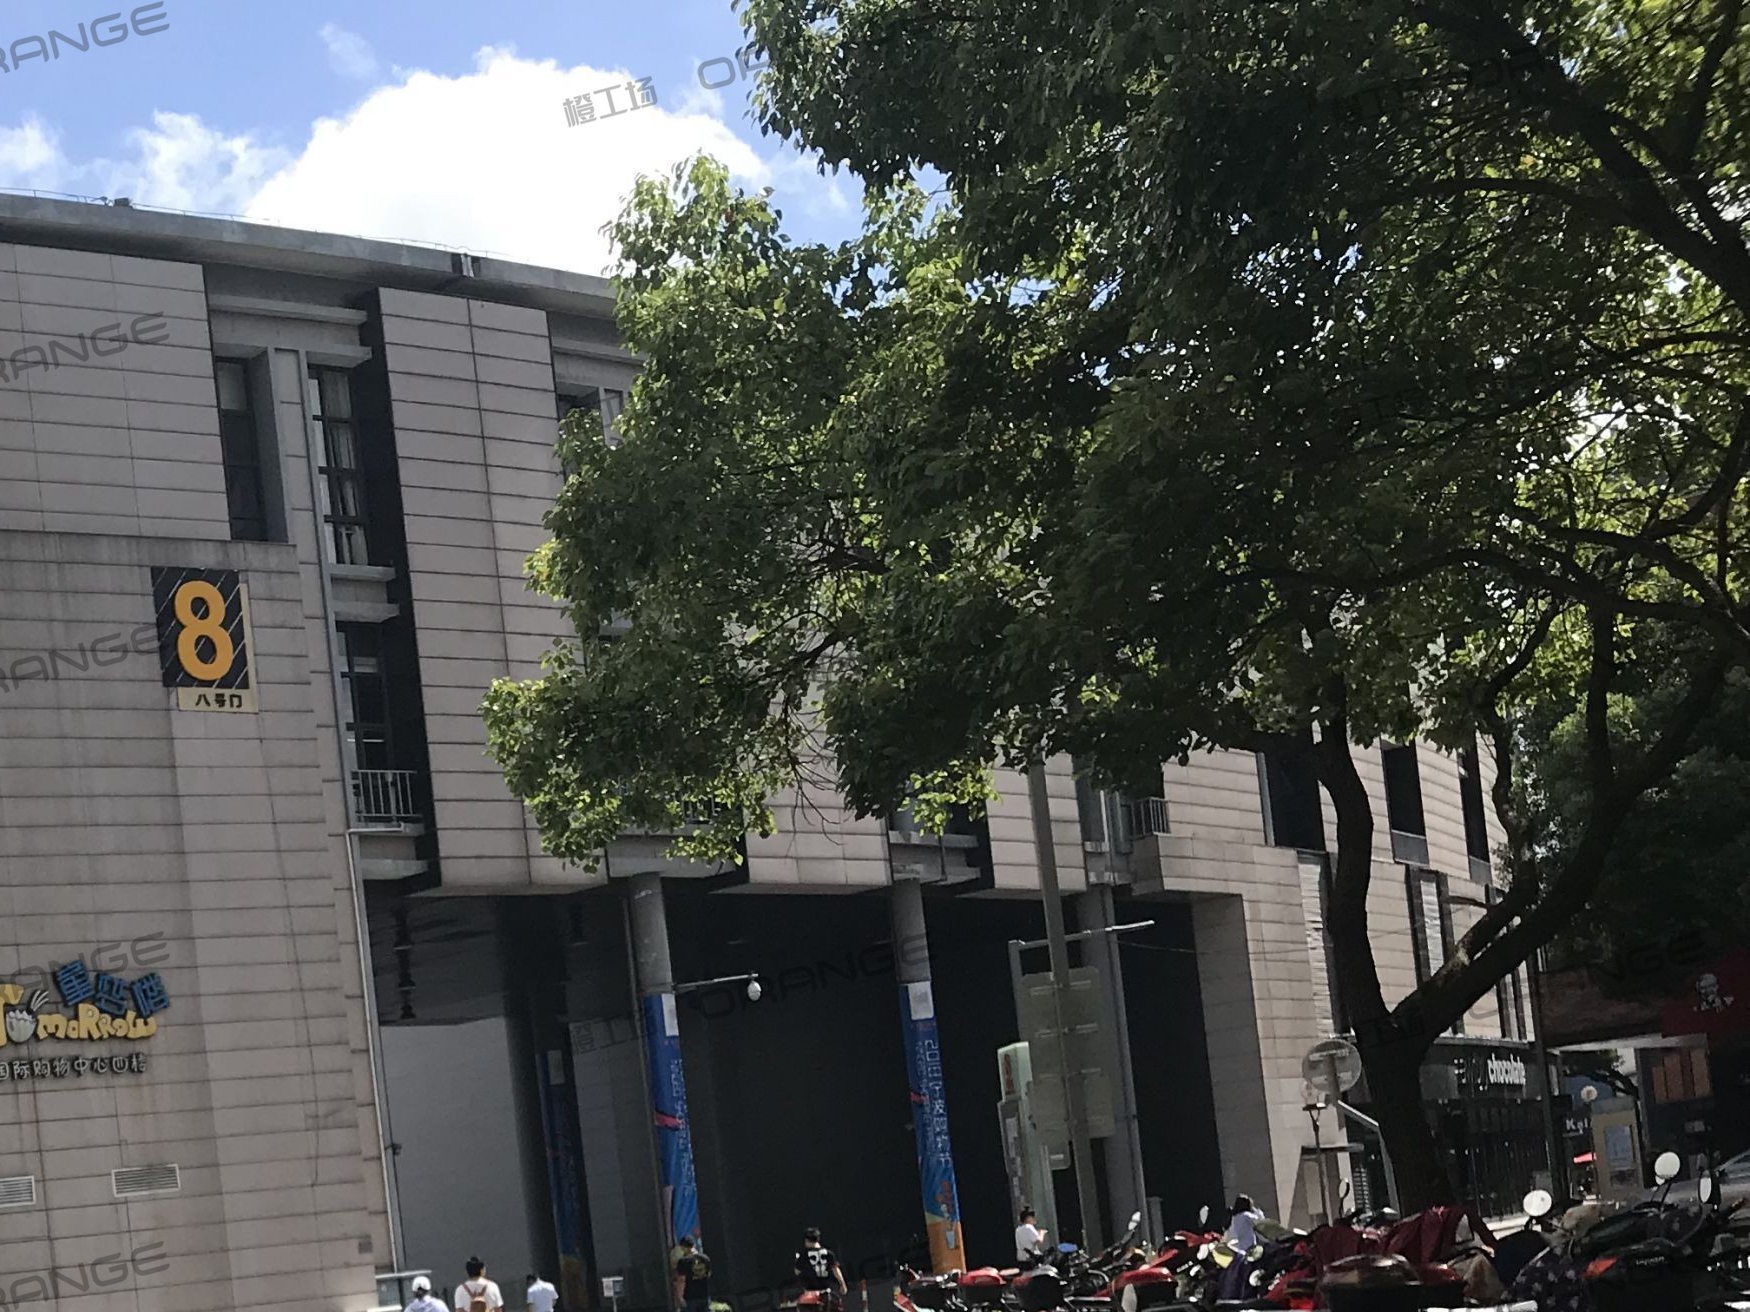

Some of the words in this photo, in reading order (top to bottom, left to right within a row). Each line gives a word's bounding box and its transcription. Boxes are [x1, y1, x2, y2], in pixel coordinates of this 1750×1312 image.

[174, 580, 234, 681] 8
[195, 692, 243, 708] 八号门
